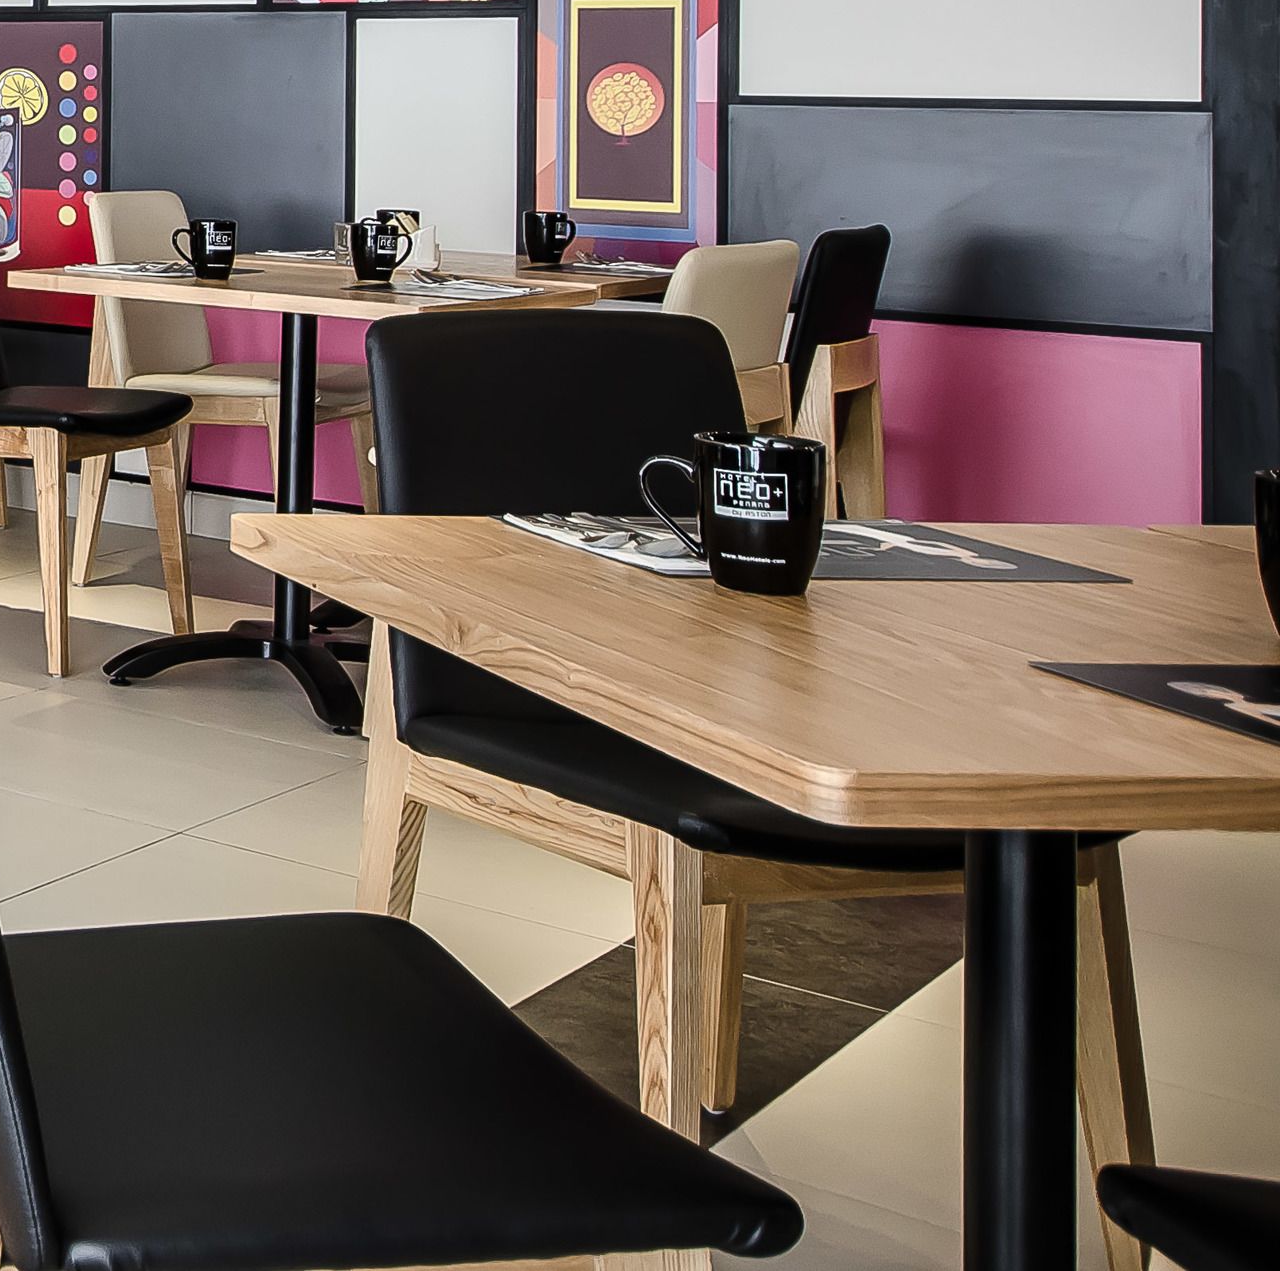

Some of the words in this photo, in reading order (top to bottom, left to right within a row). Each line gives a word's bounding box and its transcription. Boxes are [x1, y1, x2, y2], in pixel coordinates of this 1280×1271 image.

[720, 472, 757, 483] HOTEL
[732, 499, 771, 509] PENANG
[744, 510, 772, 518] ASTON
